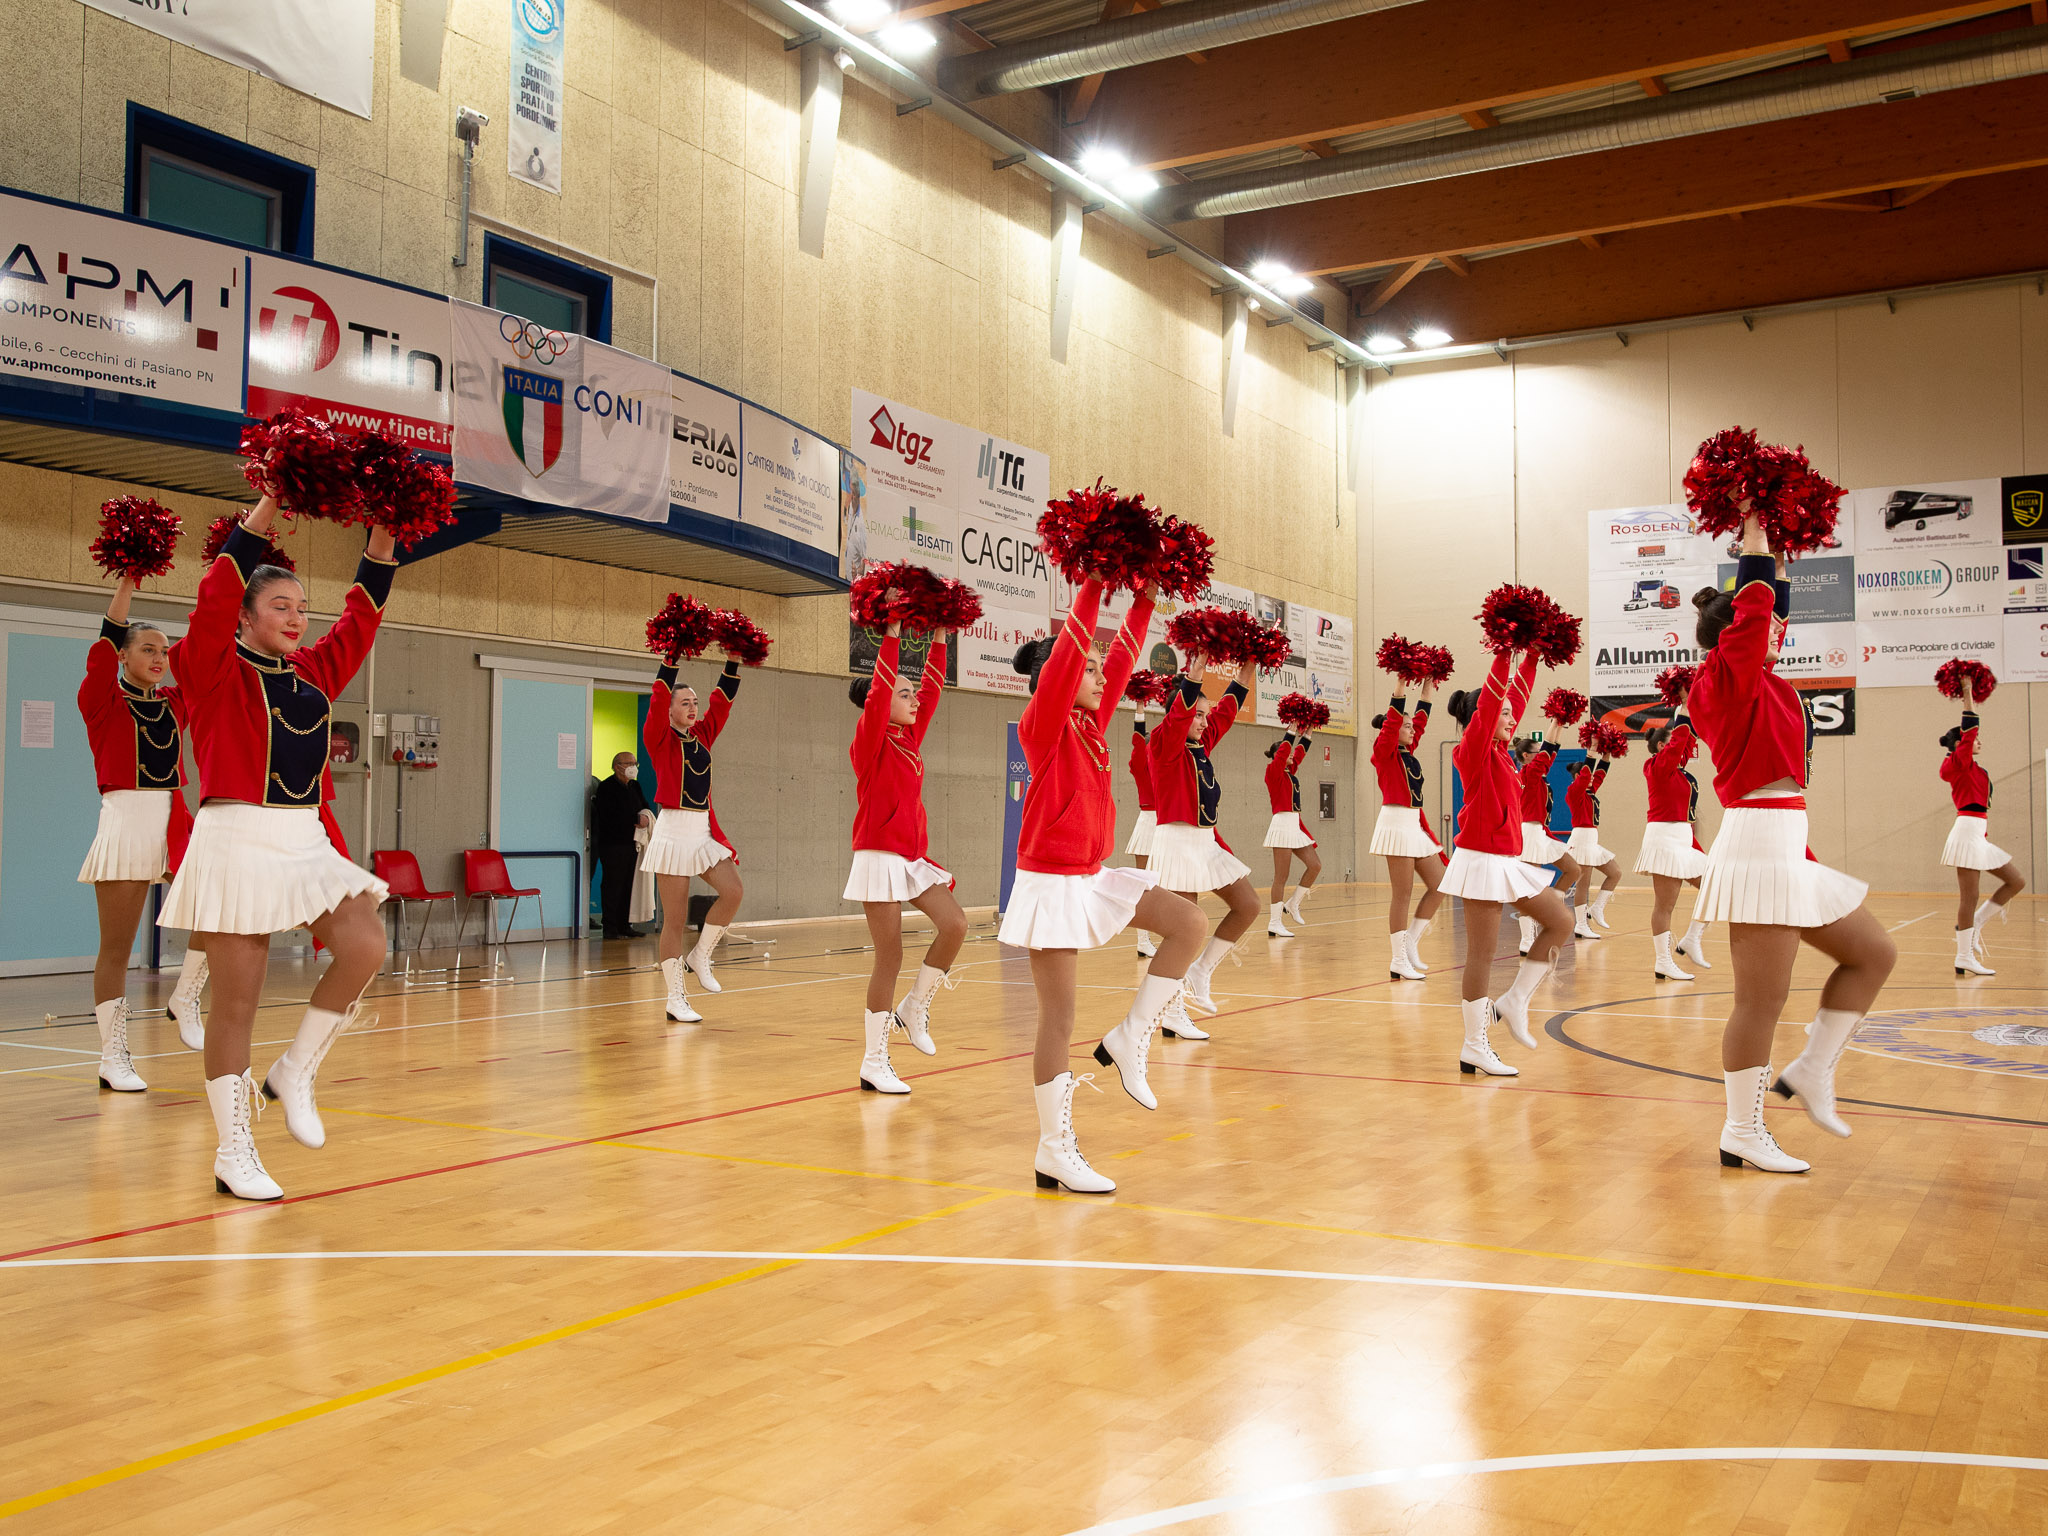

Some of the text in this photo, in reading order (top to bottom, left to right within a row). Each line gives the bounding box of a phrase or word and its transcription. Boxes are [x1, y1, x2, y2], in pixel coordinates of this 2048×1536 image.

[525, 62, 552, 86] CENTRO
[520, 75, 555, 102] SPORTIVO
[521, 90, 554, 117] PRATA DI
[0, 243, 193, 323] APM
[34, 342, 43, 353] 6
[60, 346, 119, 366] Cecchini
[124, 357, 136, 369] di
[142, 361, 192, 379] Pasiano
[197, 370, 214, 383] PN
[509, 372, 559, 400] ITALIA
[573, 384, 642, 426] CONI
[896, 422, 934, 466] tgz
[692, 450, 738, 478] 2000
[746, 451, 775, 474] CANTIERI
[808, 478, 831, 499] GIORGIO
[917, 462, 946, 477] SERRAMENTI
[688, 482, 719, 499] Pordenone
[1018, 494, 1035, 504] metallica
[864, 519, 910, 544] ARMACIA
[1610, 522, 1680, 535] ROSOLEN
[1892, 535, 1925, 544] Autoservizi
[917, 533, 953, 555] BISATTI
[922, 549, 932, 558] alla
[931, 552, 940, 560] tua
[961, 527, 1048, 582] CAGIPA
[1857, 564, 2000, 589] NOXORSOKEM GROUP
[976, 578, 1036, 599] www.cagipa.com
[1872, 604, 1985, 618] www.noxorsokem.it
[1002, 631, 1010, 645] e
[1881, 640, 1996, 654] Banca Popolare di Cividale
[1595, 647, 1709, 667] Allumini
[966, 669, 975, 677] Via
[975, 670, 990, 680] Dante,
[996, 673, 1009, 682] 33070
[1595, 668, 1624, 676] LAVORAZIONI
